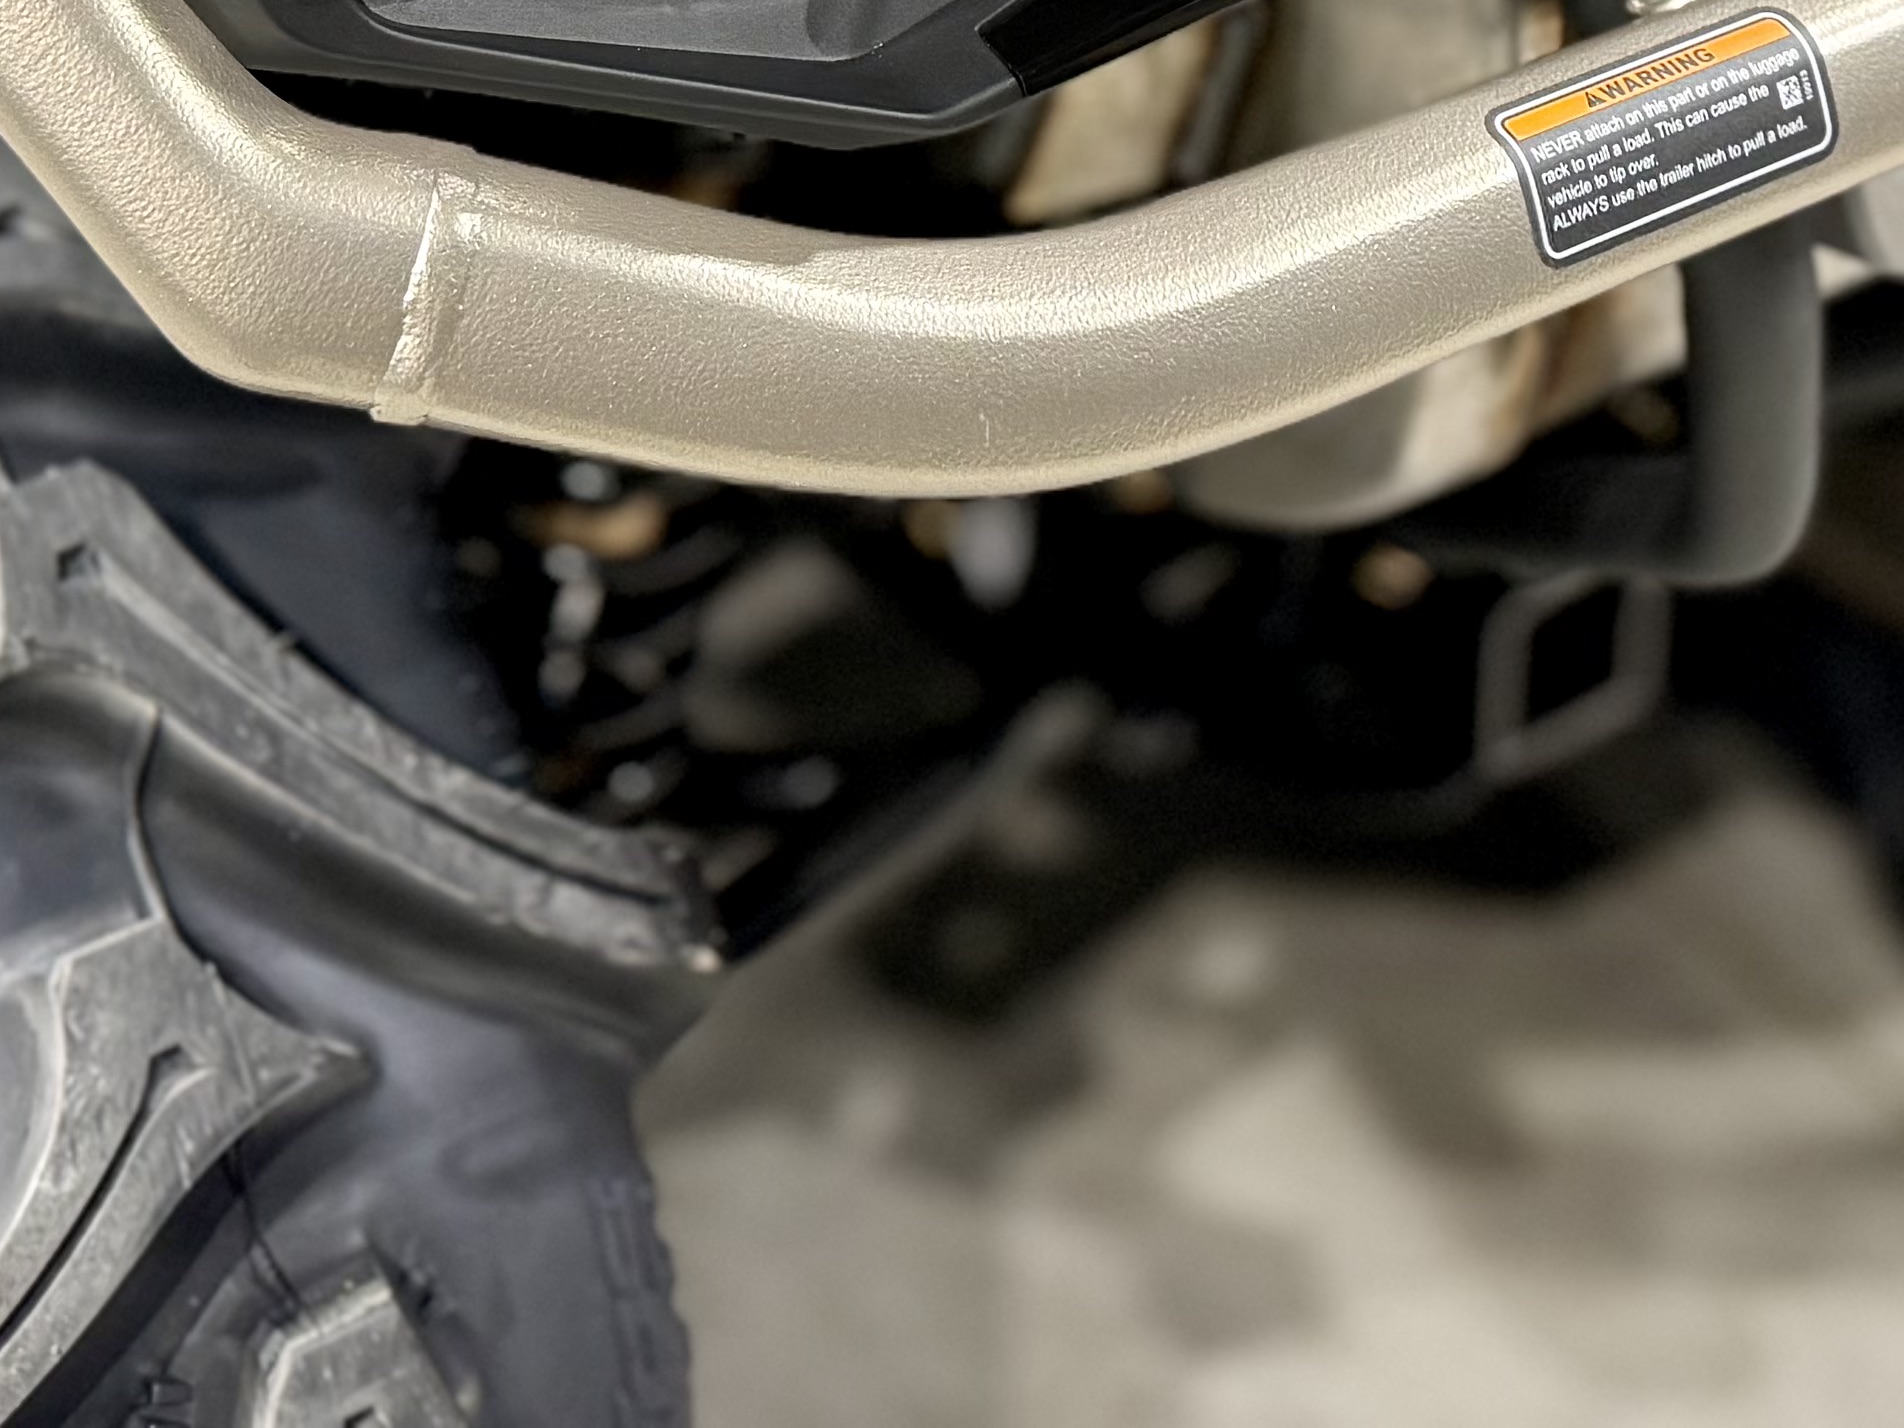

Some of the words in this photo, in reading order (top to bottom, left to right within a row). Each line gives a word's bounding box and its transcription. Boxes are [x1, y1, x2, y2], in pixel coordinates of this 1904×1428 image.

[1530, 130, 1585, 164] NEVER
[1584, 115, 1625, 143] attach
[1625, 108, 1644, 126] on
[1643, 96, 1669, 119] this
[1668, 86, 1697, 112] part
[1697, 82, 1711, 98] or
[1711, 76, 1729, 92] on
[1727, 67, 1750, 86] the
[1748, 47, 1801, 76] luggage
[1598, 48, 1715, 100] WARNING
[1541, 162, 1571, 186] rack
[1570, 158, 1586, 173] to
[1586, 144, 1611, 171] pull
[1611, 141, 1623, 158] a
[1622, 126, 1656, 152] load.
[1655, 116, 1685, 139] This
[1684, 108, 1710, 126] can
[1710, 93, 1748, 117] cause
[1747, 83, 1770, 102] the
[1547, 180, 1593, 209] vehicle
[1593, 172, 1608, 190] to
[1608, 162, 1627, 184] tip
[1627, 153, 1660, 176] over.
[1552, 194, 1610, 232] ALWAYS
[1611, 187, 1635, 207] use
[1636, 177, 1658, 196] the
[1658, 161, 1695, 188] trailer
[1695, 147, 1728, 173] hitch
[1727, 143, 1743, 159] to
[1743, 129, 1766, 157] pull
[1766, 129, 1777, 144] a
[1776, 114, 1809, 139] load.
